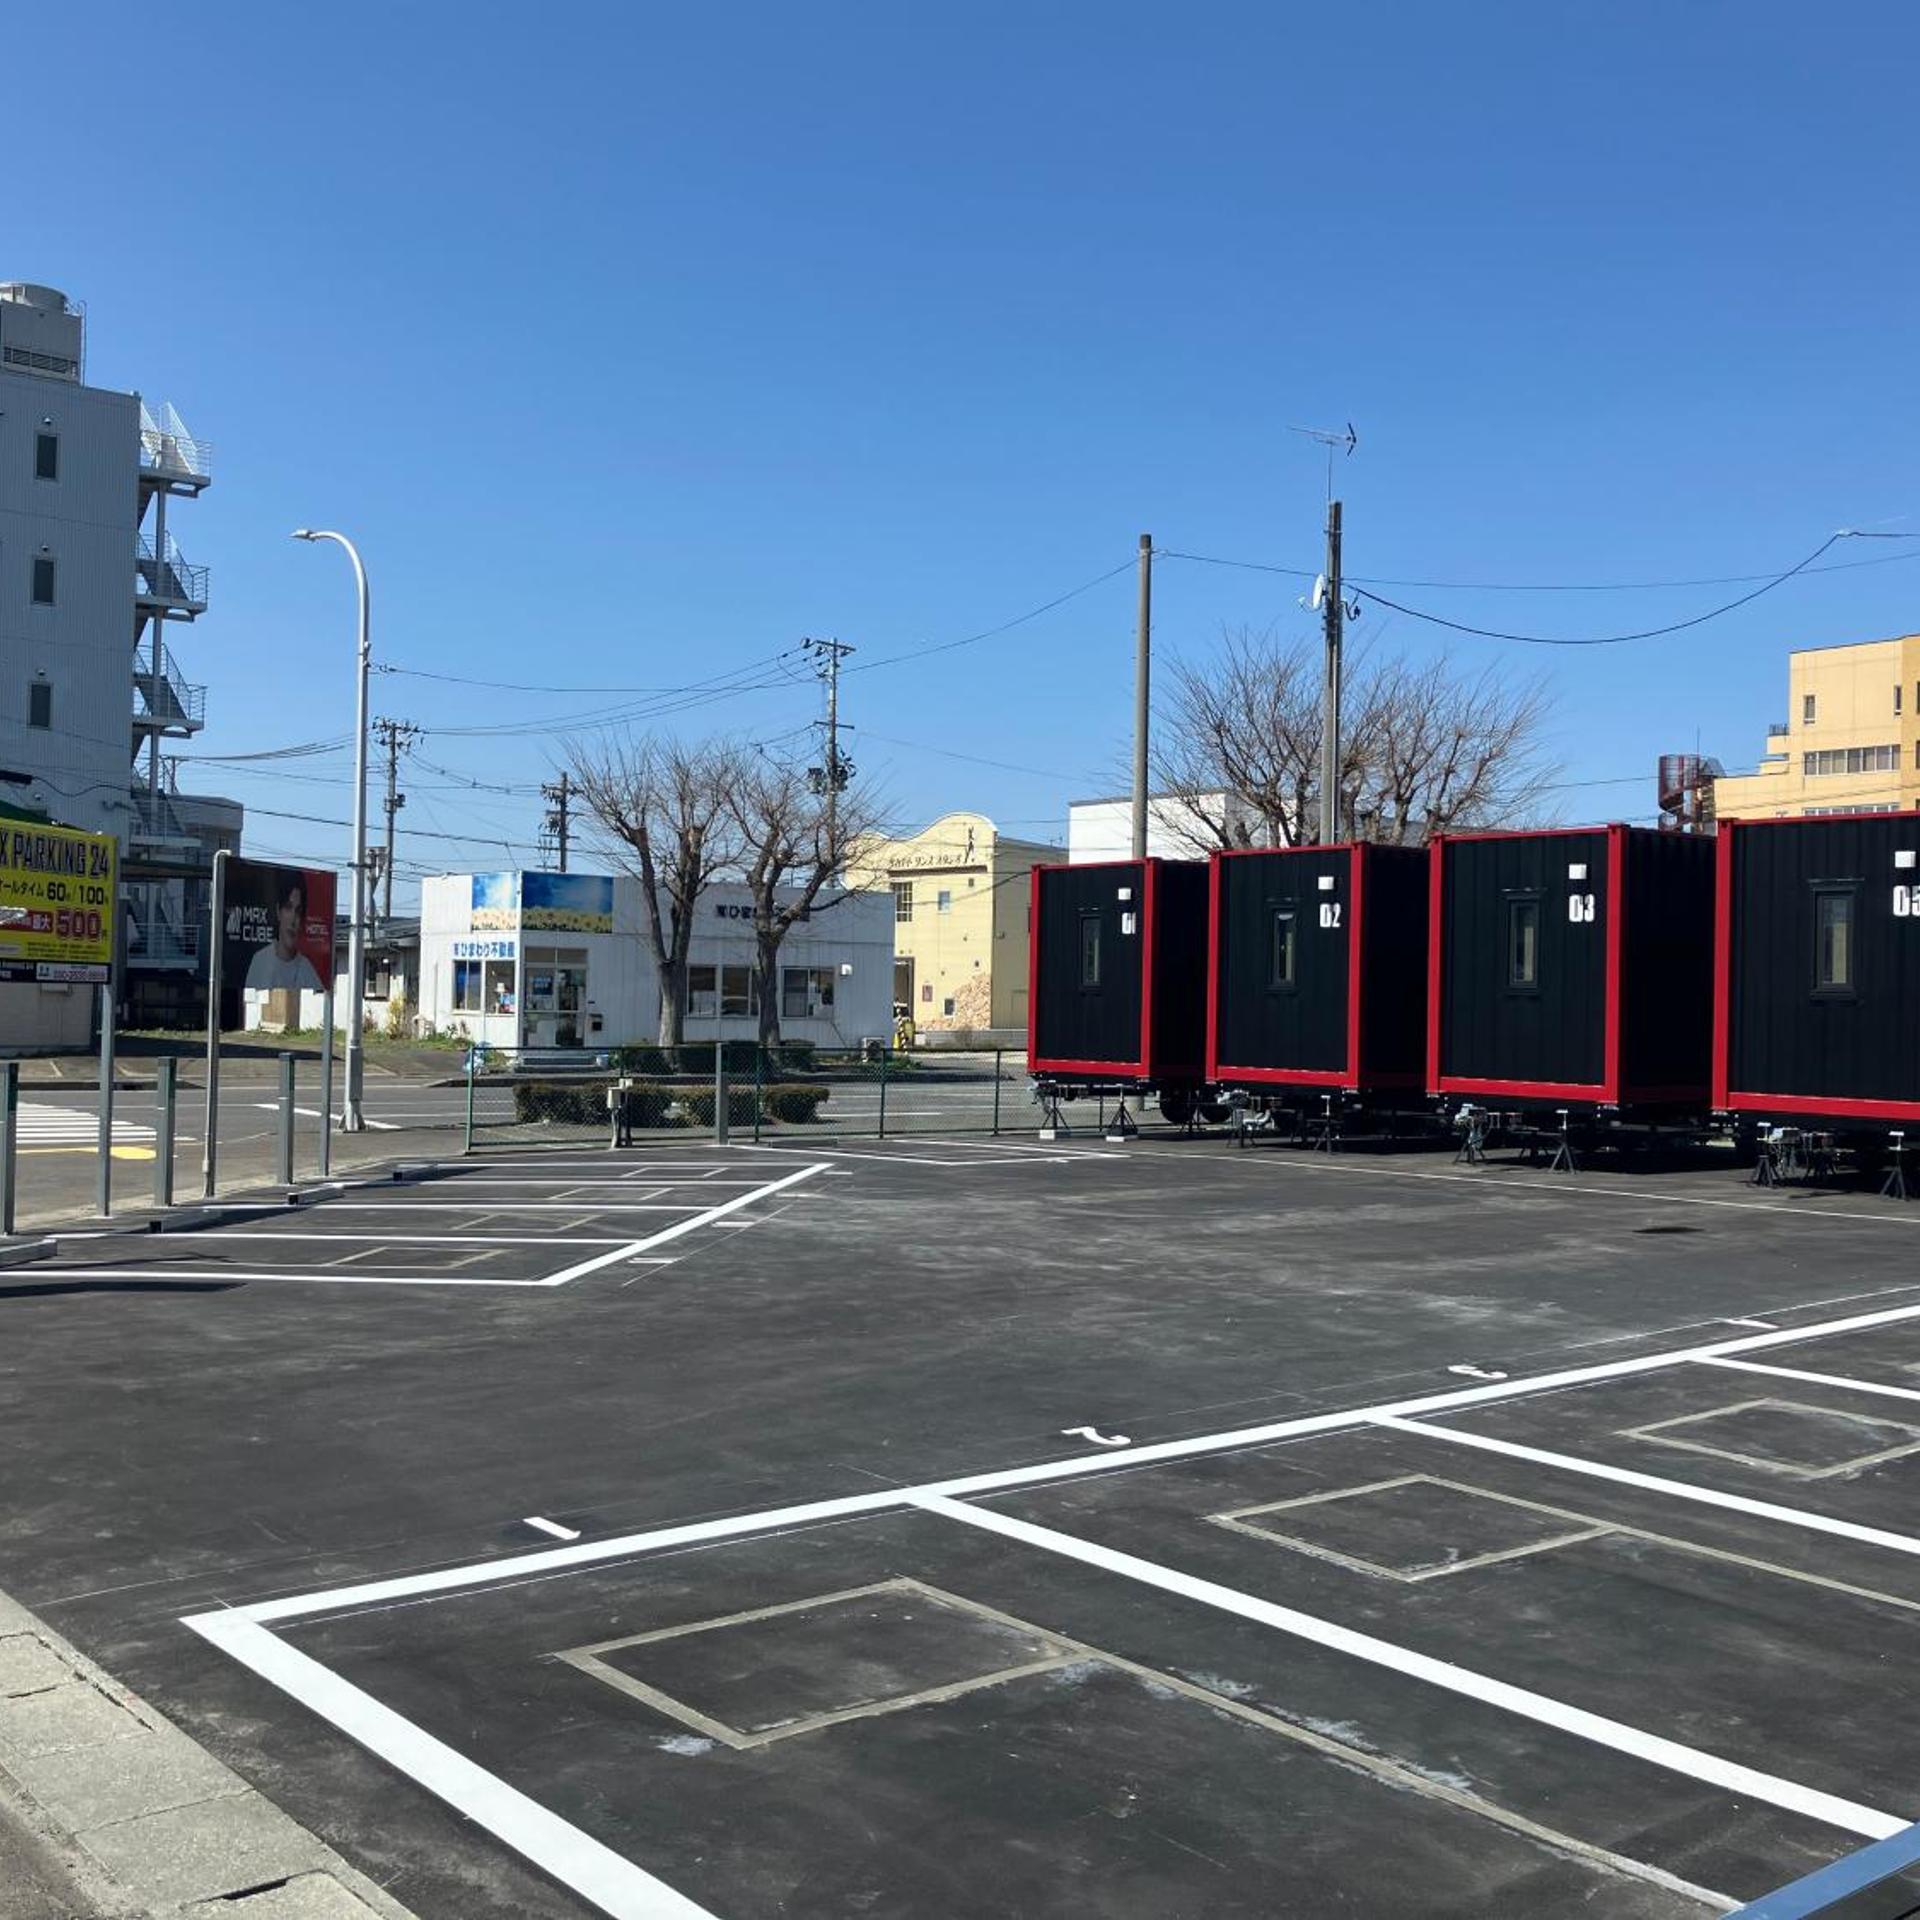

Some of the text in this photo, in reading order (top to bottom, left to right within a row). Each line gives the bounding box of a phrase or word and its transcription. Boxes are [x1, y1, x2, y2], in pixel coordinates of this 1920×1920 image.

[14, 832, 86, 875] PARKING
[90, 843, 108, 876] 24
[243, 906, 268, 925] MAX
[1319, 903, 1341, 928] 02
[1568, 893, 1594, 922] 03
[243, 925, 273, 942] CUBE
